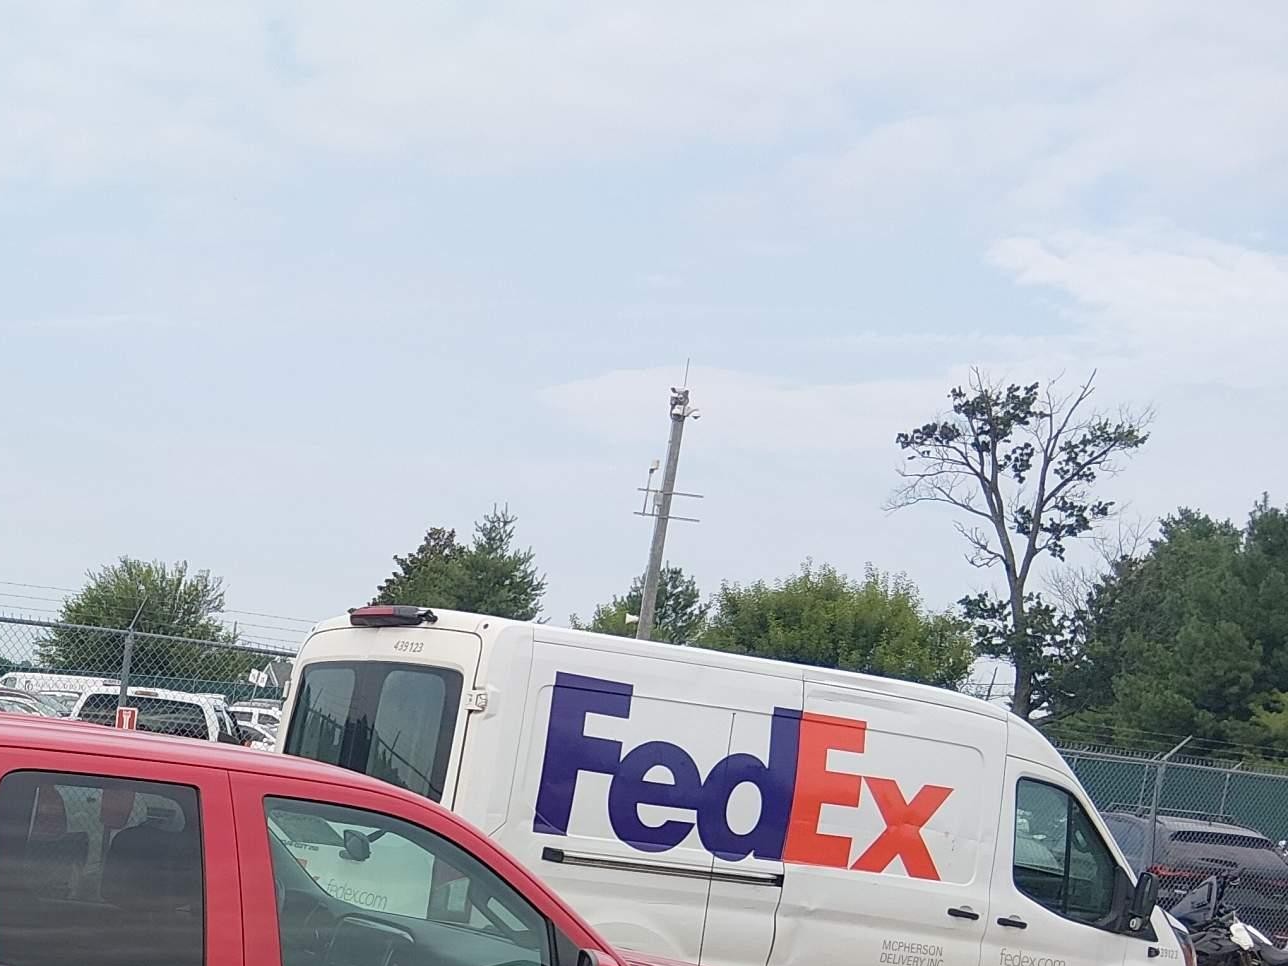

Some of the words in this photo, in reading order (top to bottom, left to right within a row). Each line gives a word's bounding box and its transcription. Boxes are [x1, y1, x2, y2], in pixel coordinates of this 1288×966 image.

[393, 640, 424, 653] 439123
[533, 671, 954, 881] FedEx
[882, 939, 943, 957] MCPHERSON
